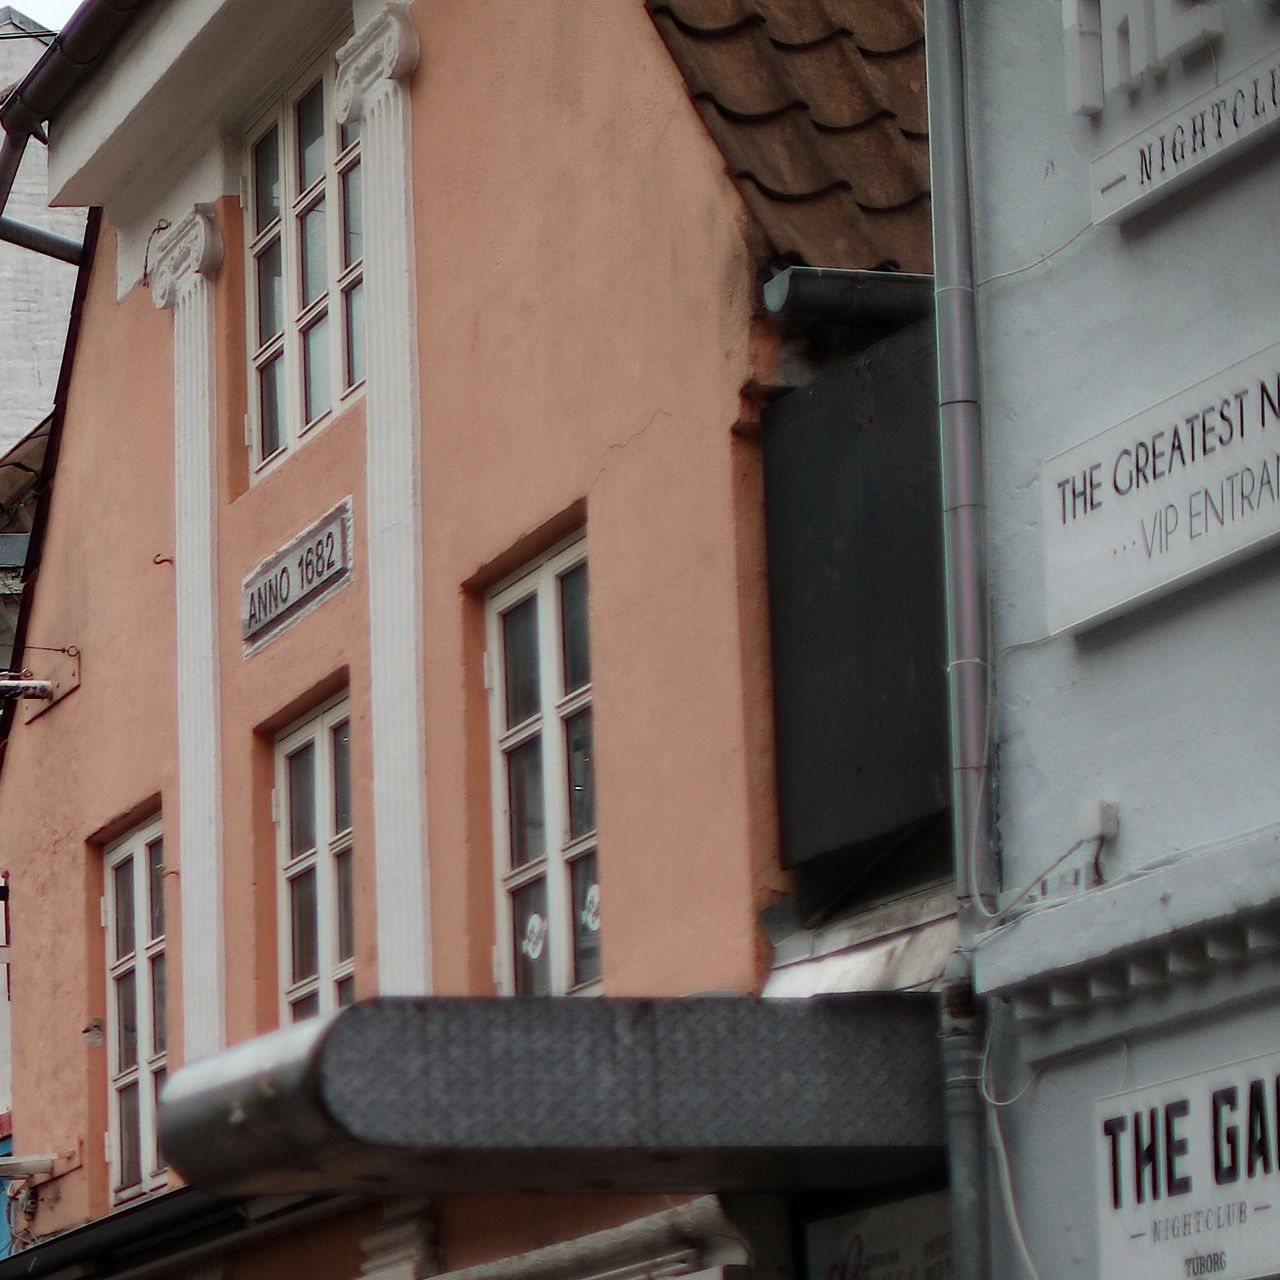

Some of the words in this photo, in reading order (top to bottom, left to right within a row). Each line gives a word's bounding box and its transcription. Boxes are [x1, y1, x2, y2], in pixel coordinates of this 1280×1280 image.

[1057, 463, 1104, 526] THE
[1113, 388, 1249, 497] GREATEST
[1189, 452, 1280, 541] ENTRA
[248, 566, 291, 629] ANNO
[297, 531, 336, 591] 1682
[1103, 1098, 1194, 1210] THE
[1212, 1073, 1280, 1186] GA
[1150, 1200, 1249, 1244] NIGHTCLUB
[1184, 1250, 1227, 1278] TUBORG
